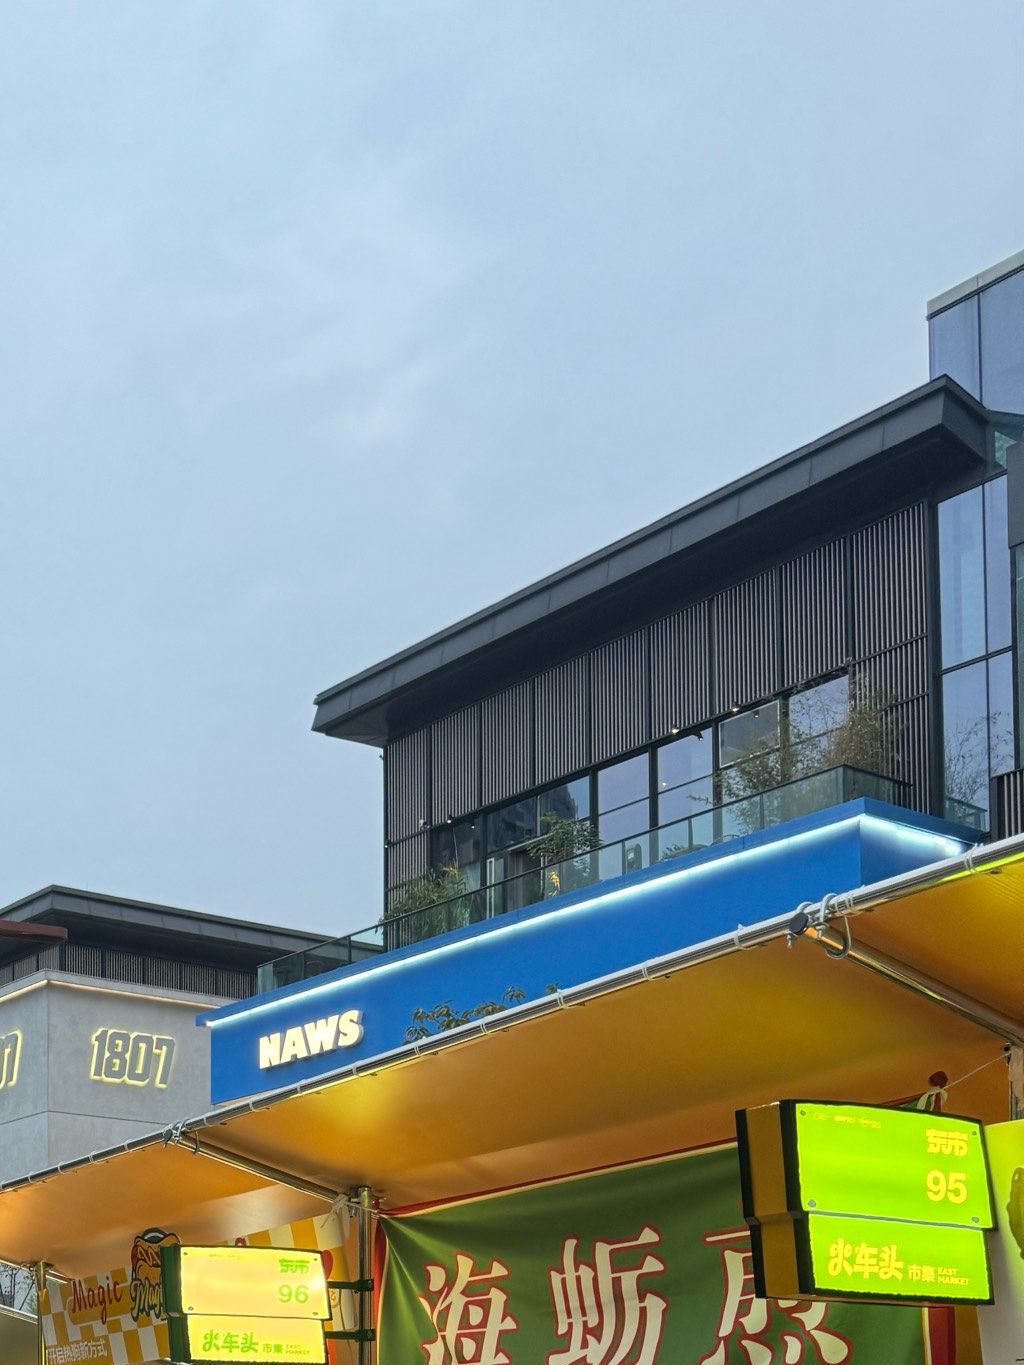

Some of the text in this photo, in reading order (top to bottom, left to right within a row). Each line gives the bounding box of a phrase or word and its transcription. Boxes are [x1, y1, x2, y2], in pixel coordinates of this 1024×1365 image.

[259, 1010, 364, 1070] NAWS
[90, 1028, 176, 1088] 1807
[926, 1128, 968, 1157] 东市
[926, 1169, 968, 1204] 95
[828, 1238, 935, 1282] 火车头 市集
[938, 1267, 957, 1276] EAST
[278, 1284, 309, 1304] 96
[938, 1276, 970, 1286] MARKET
[72, 1276, 123, 1325] Magic
[202, 1329, 259, 1354] 火车头
